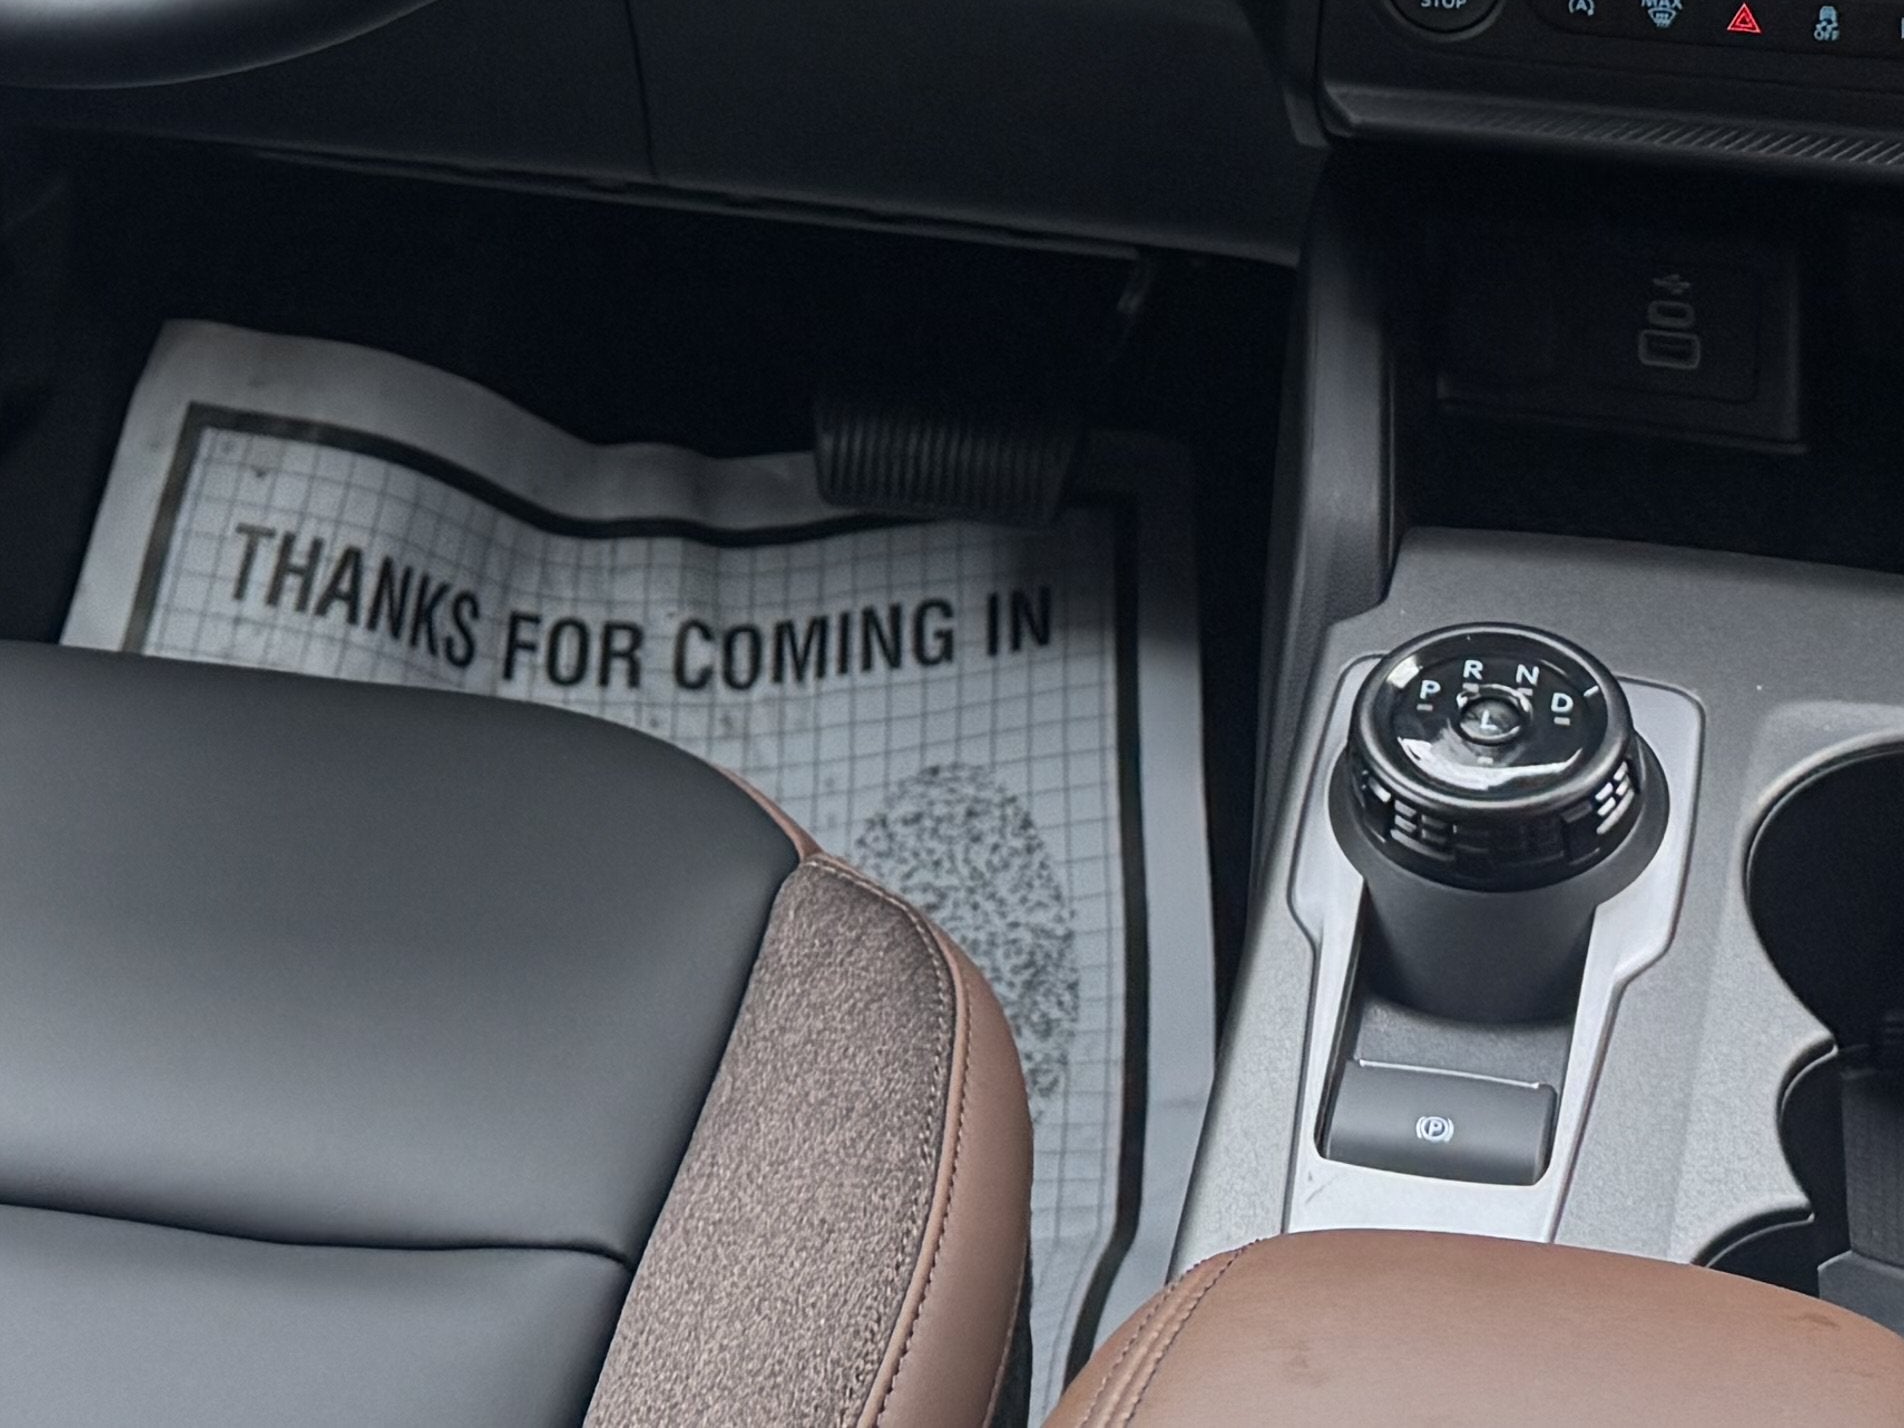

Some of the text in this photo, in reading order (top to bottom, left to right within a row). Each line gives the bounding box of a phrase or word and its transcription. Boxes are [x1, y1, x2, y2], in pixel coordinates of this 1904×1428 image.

[230, 521, 1053, 692] THANKS FOR COMING IN
[1419, 659, 1574, 714] P R N D
